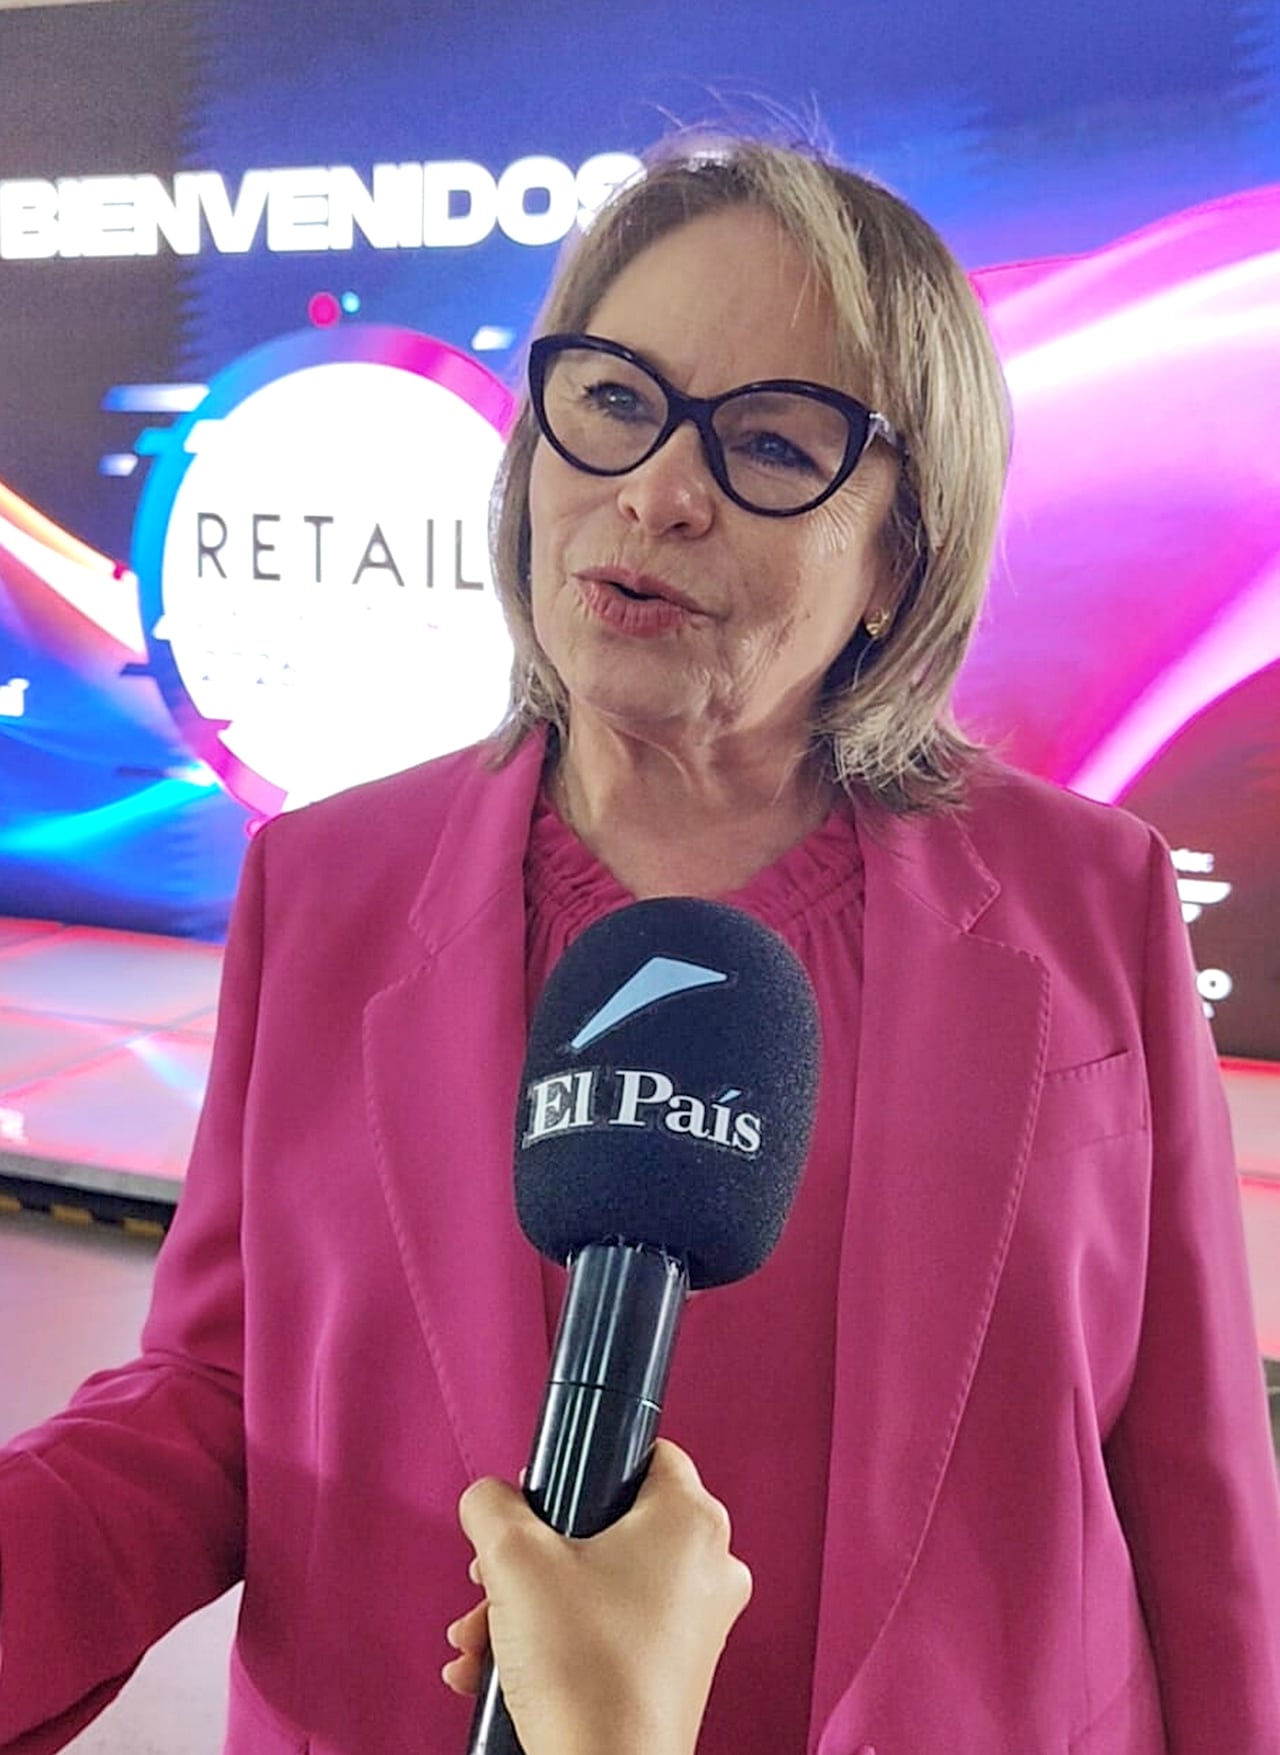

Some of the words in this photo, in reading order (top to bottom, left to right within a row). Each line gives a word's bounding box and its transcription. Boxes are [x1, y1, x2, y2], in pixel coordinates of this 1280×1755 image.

[197, 511, 485, 590] RETAIL
[527, 1071, 594, 1140] El
[608, 1069, 761, 1152] País
